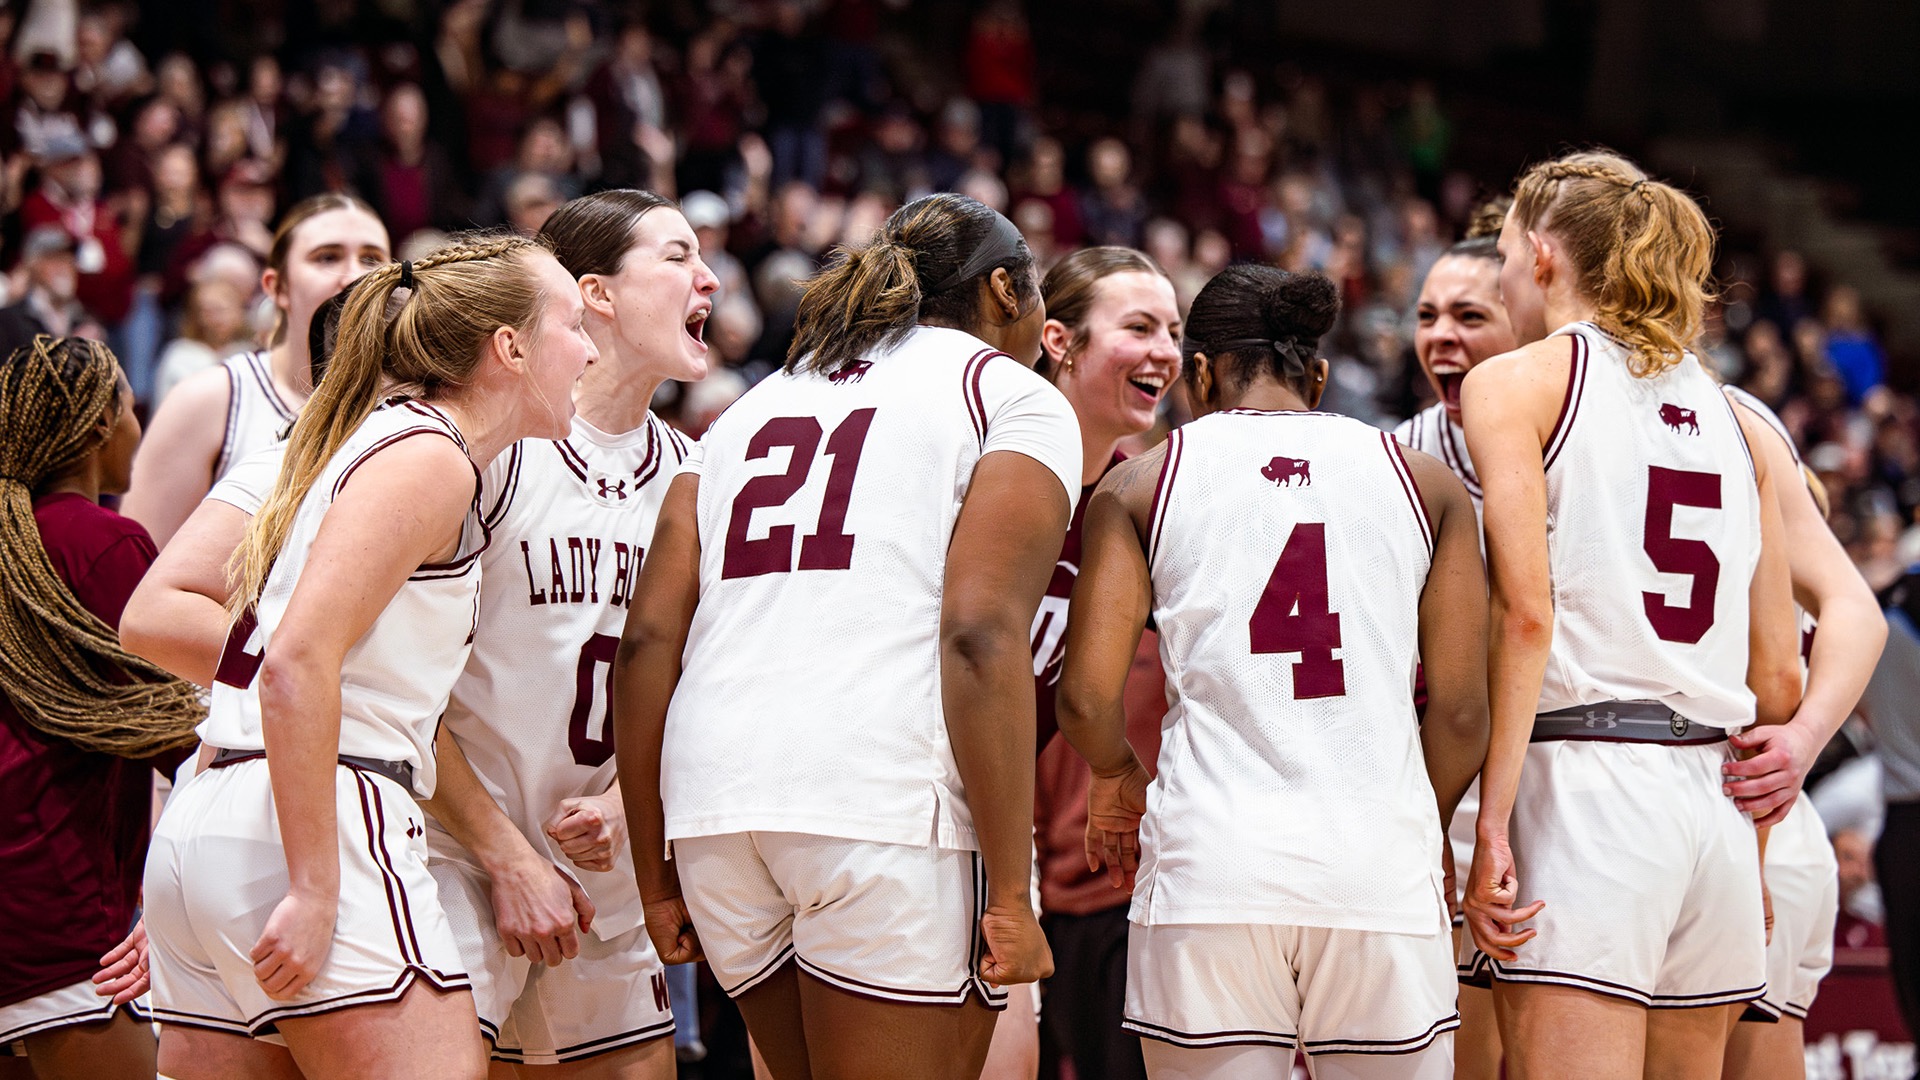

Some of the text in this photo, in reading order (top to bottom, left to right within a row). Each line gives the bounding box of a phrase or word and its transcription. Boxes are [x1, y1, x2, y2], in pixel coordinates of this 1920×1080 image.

[520, 537, 601, 606] LADY
[721, 407, 877, 580] 21
[1641, 465, 1722, 645] 5
[1249, 522, 1346, 700] 4
[568, 632, 621, 767] 0
